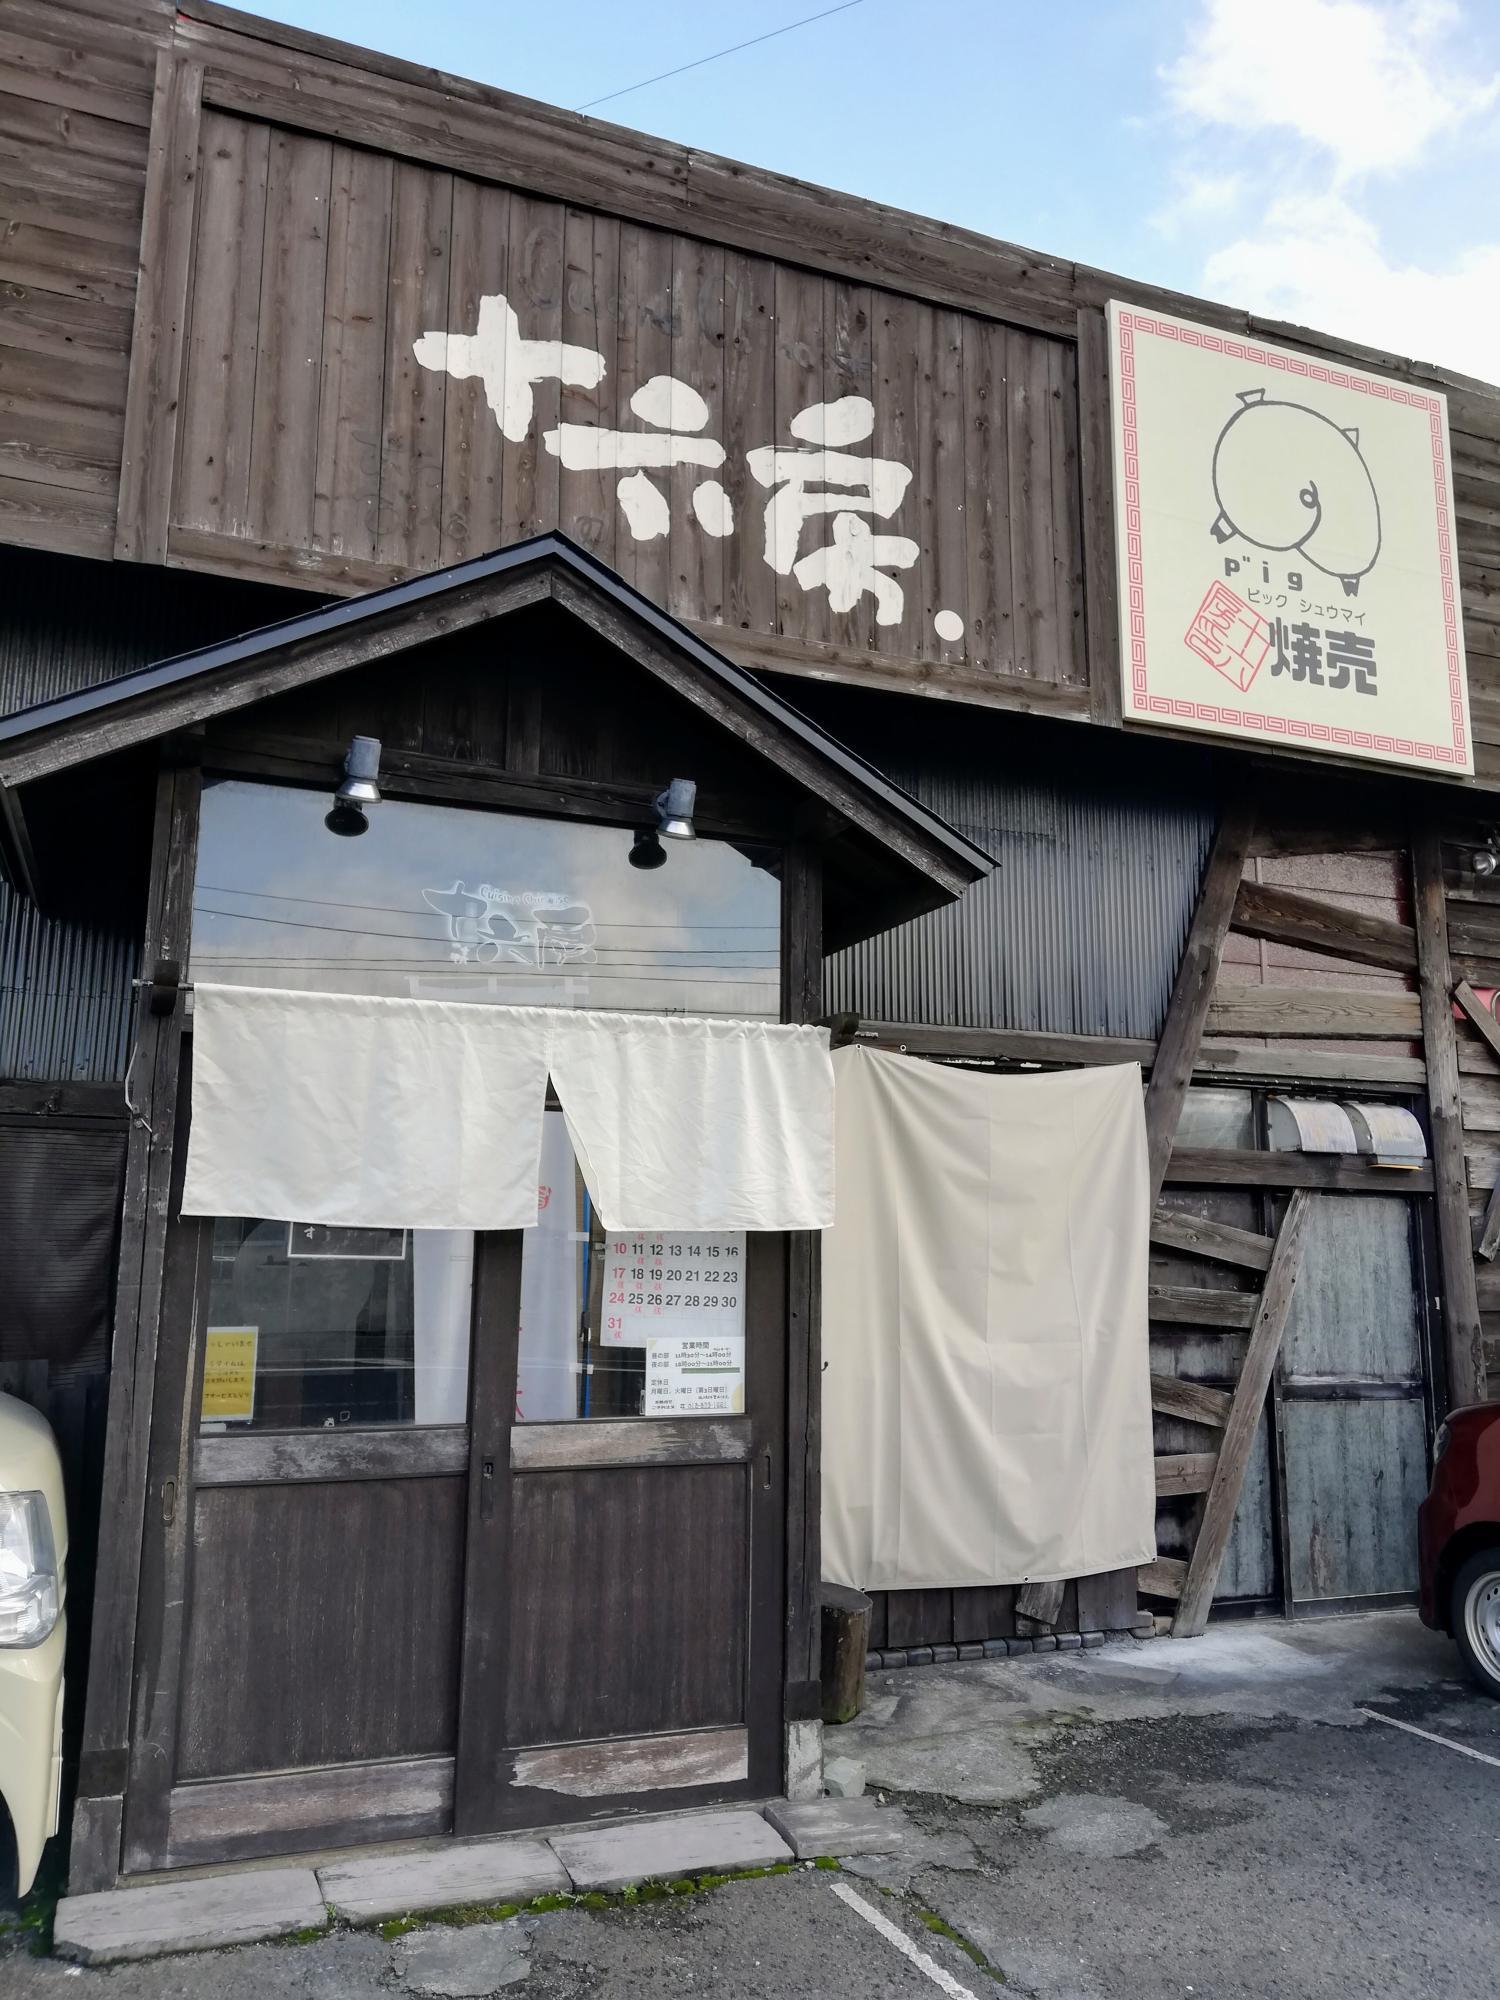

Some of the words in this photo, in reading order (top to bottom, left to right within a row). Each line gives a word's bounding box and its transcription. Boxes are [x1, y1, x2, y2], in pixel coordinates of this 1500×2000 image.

[1299, 599, 1367, 626] シュウマイ
[1268, 616, 1378, 697] 焼売
[613, 1242, 627, 1254] 10
[632, 1243, 644, 1255] 11
[649, 1244, 664, 1256] 12
[668, 1245, 682, 1257] 13
[687, 1246, 702, 1257] 14
[706, 1246, 720, 1258] 15
[724, 1247, 739, 1257] 16
[612, 1267, 626, 1279] 17
[630, 1268, 644, 1280] 18
[649, 1268, 663, 1280] 19
[666, 1269, 682, 1281] 20
[685, 1270, 700, 1282] 21
[704, 1271, 720, 1282] 22
[723, 1271, 738, 1283] 23
[609, 1292, 625, 1304] 24
[628, 1293, 644, 1305] 25
[647, 1294, 663, 1306] 26
[665, 1295, 681, 1306] 27
[684, 1295, 700, 1307] 28
[703, 1296, 719, 1307] 29
[721, 1296, 737, 1308] 30
[607, 1317, 623, 1329] 31
[681, 1341, 710, 1350] 営業時間
[650, 1378, 669, 1386] 定休日
